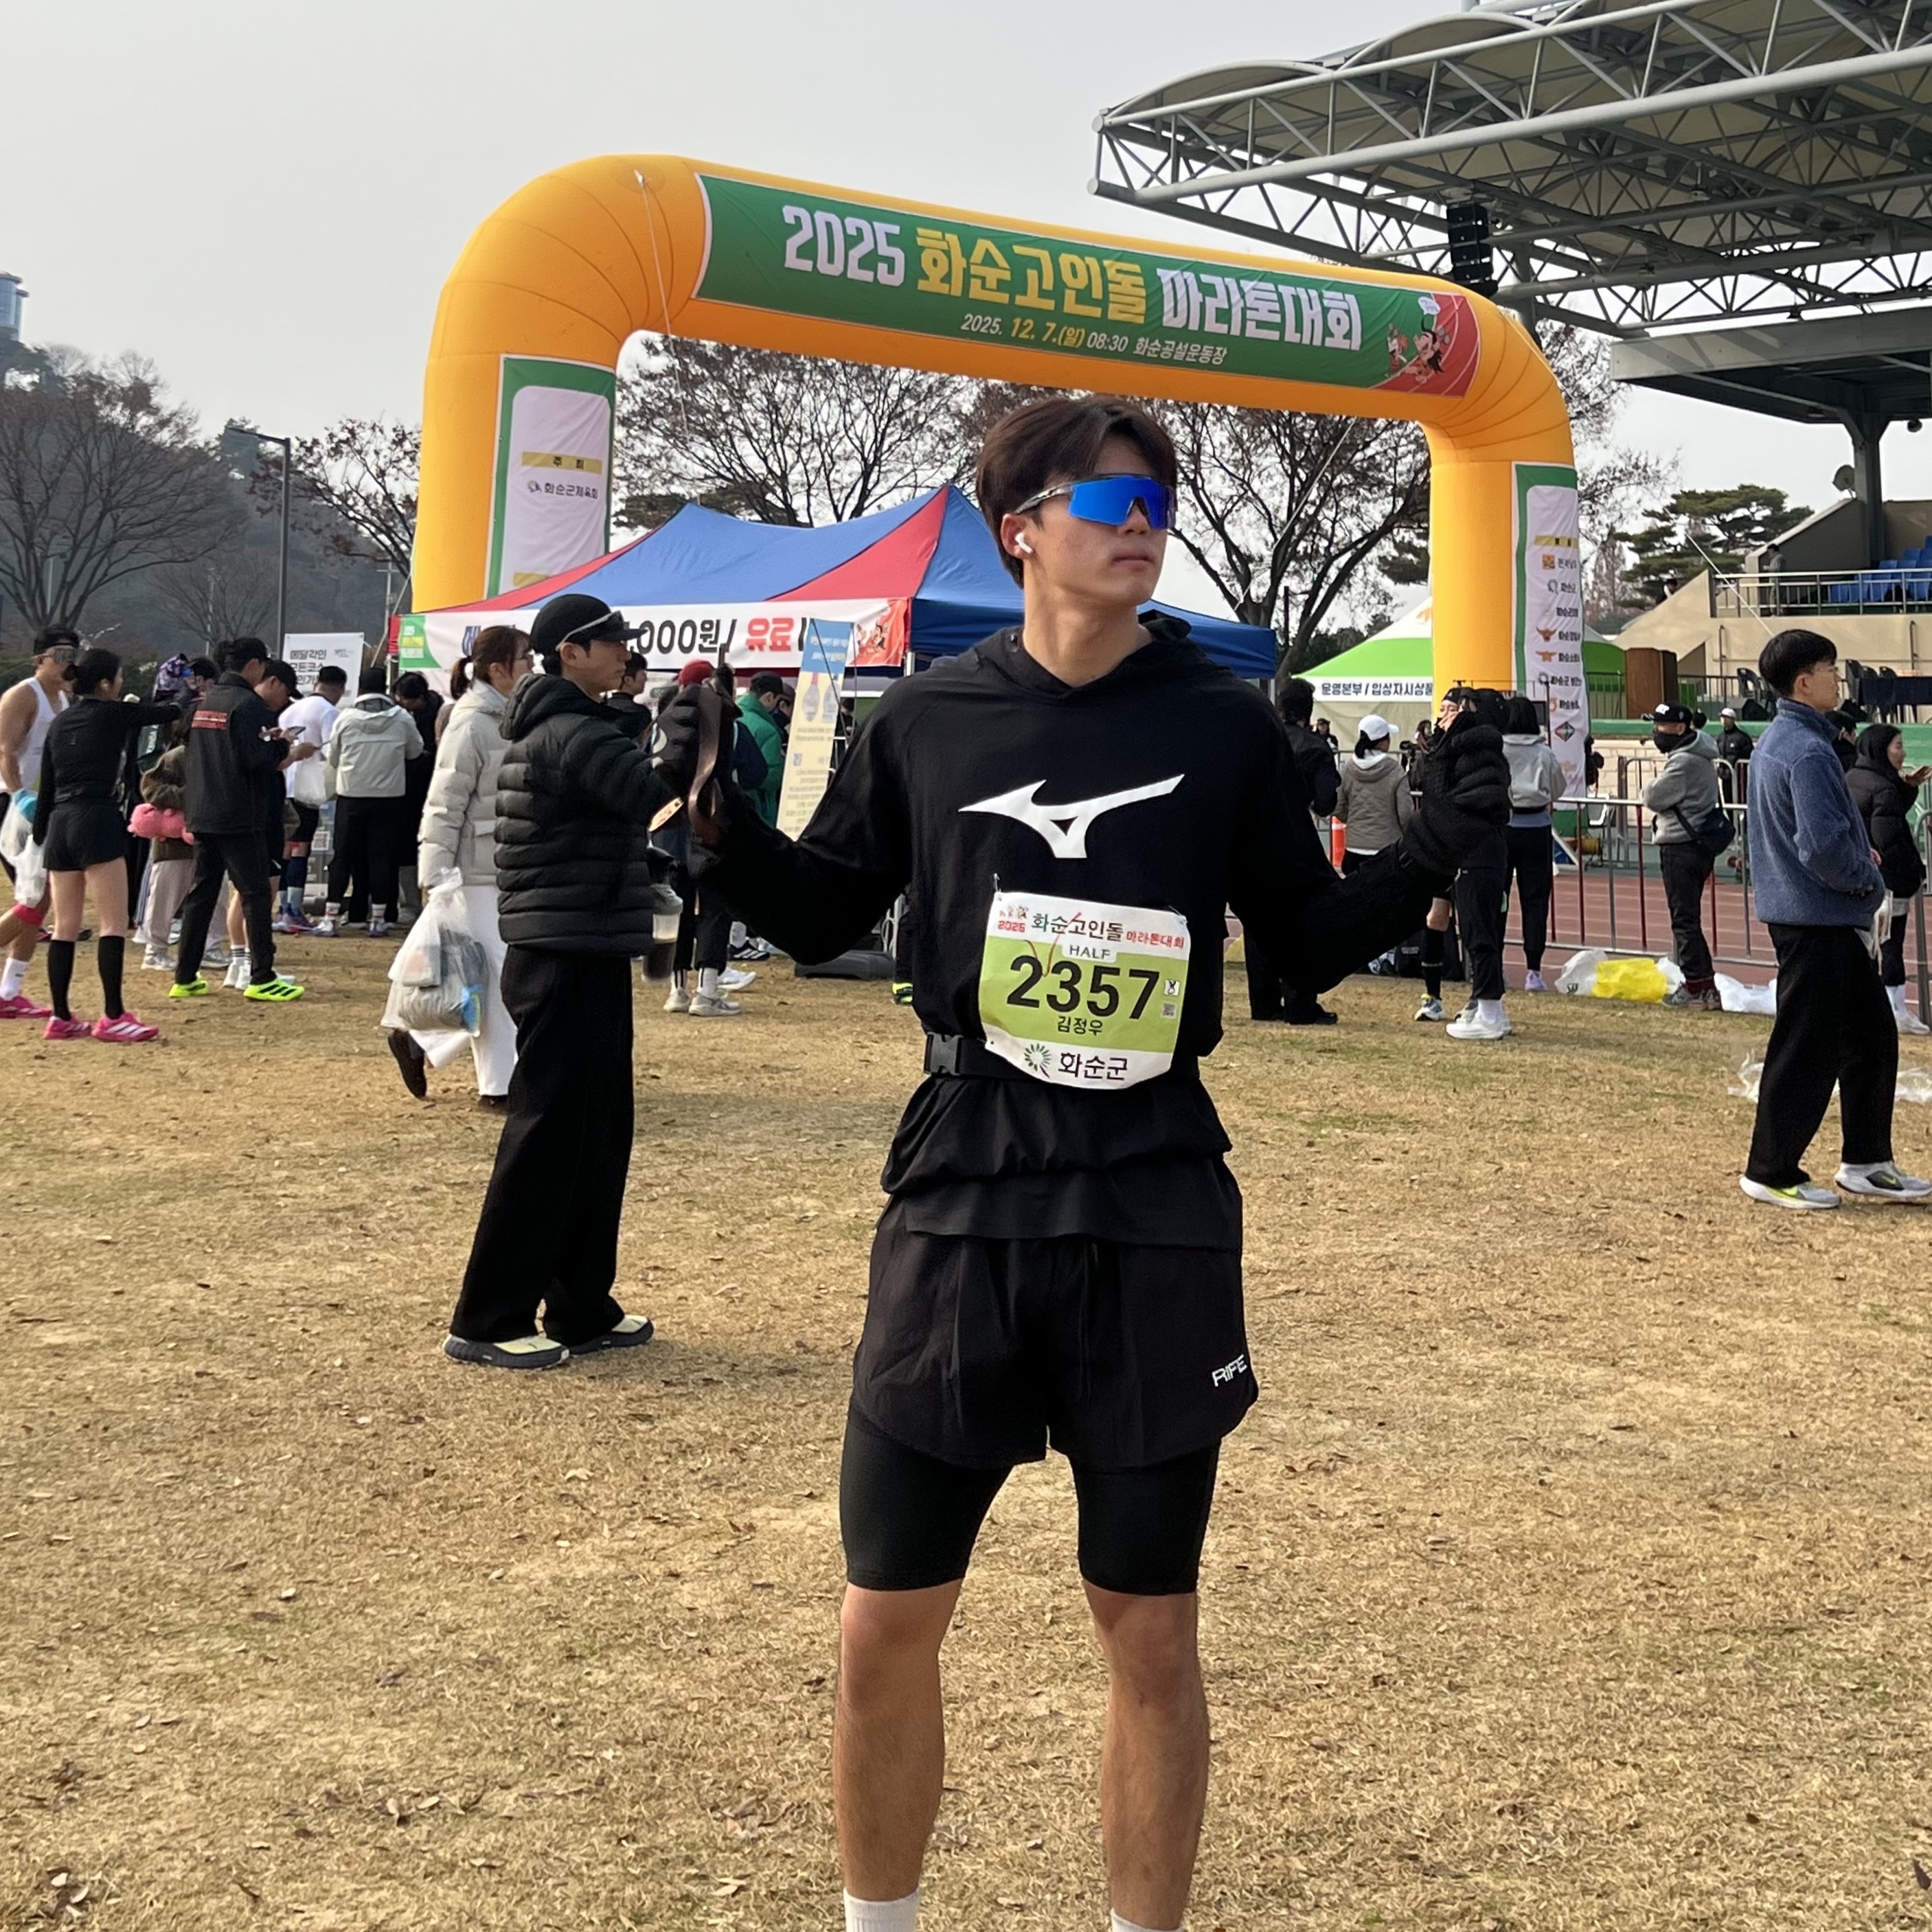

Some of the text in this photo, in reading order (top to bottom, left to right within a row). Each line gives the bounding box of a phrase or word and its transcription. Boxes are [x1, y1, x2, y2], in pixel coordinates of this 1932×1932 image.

[782, 205, 1362, 351] 2025 화순고인돌 마라톤대회
[961, 313, 1002, 336] 2025.
[1010, 317, 1036, 340] 12.
[1087, 332, 1128, 352] 08:30
[1133, 337, 1227, 365] 화순공설운동장
[545, 482, 598, 500] 화순군체육회
[746, 617, 794, 652] 유료
[1321, 682, 1362, 696] 운영본부
[1031, 913, 1123, 942] 화순고인돌
[1126, 930, 1185, 949] 마라톤대회
[1069, 944, 1111, 959] HALF
[1006, 955, 1160, 1020] 2357
[1057, 1016, 1104, 1036] 김정우
[1058, 1052, 1128, 1081] 화순군
